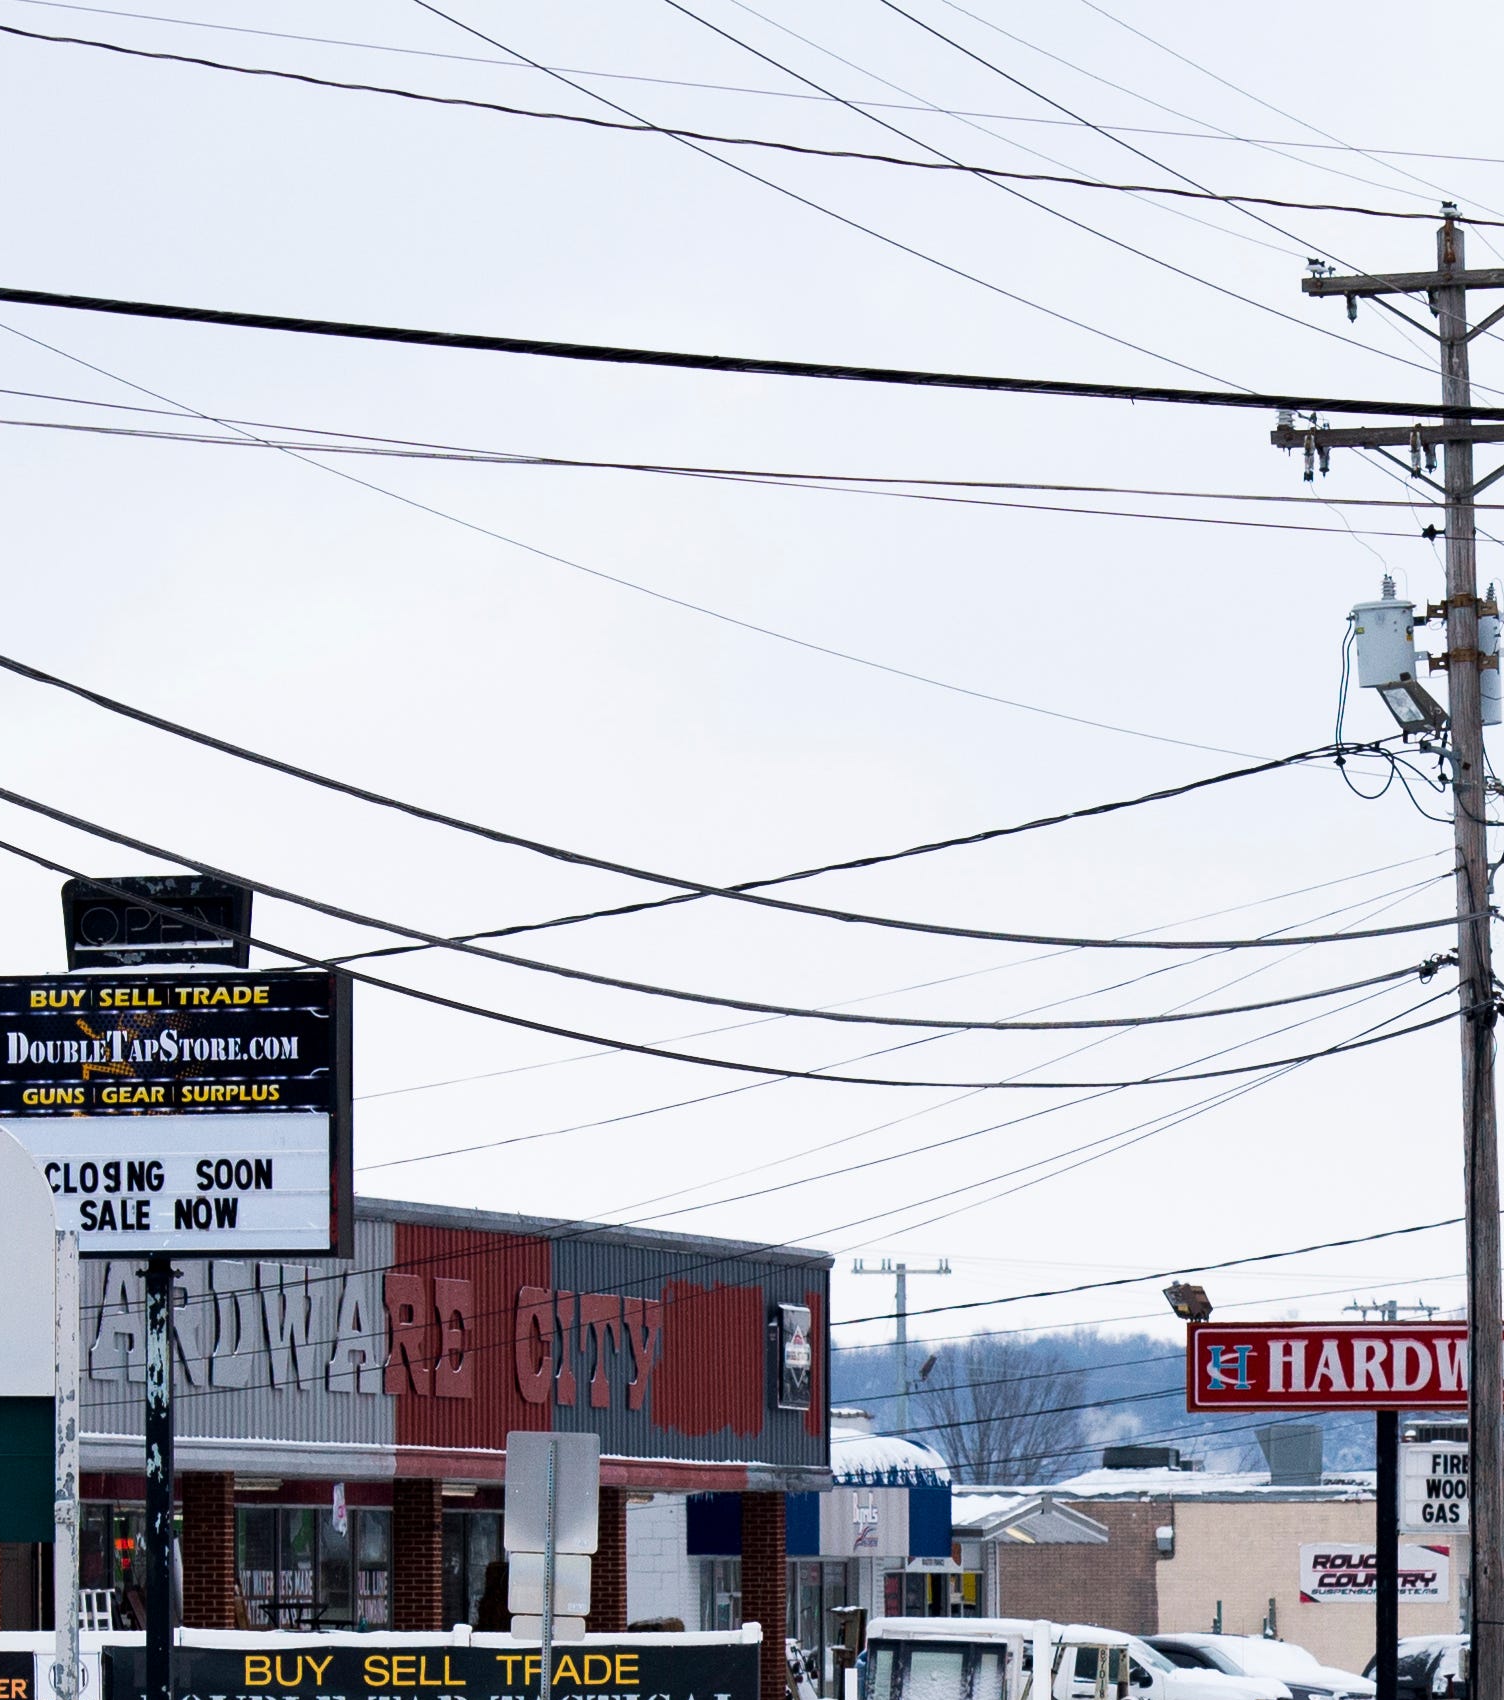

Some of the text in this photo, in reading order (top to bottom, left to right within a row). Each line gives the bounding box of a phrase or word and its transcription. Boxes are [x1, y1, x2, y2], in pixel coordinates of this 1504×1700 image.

[30, 986, 270, 1008] BUY SELL TRADE
[22, 1084, 280, 1105] GUNS GEAR SURPLUS
[45, 1158, 273, 1193] CLOSING SOON
[79, 1196, 239, 1232] SALE NOW
[90, 1260, 665, 1412] ARDWARE CITY
[1426, 1479, 1470, 1500] WOO
[1422, 1503, 1460, 1523] GAS
[1312, 1554, 1377, 1570] ROUG
[243, 1653, 641, 1687] BUY SELL TRADE
